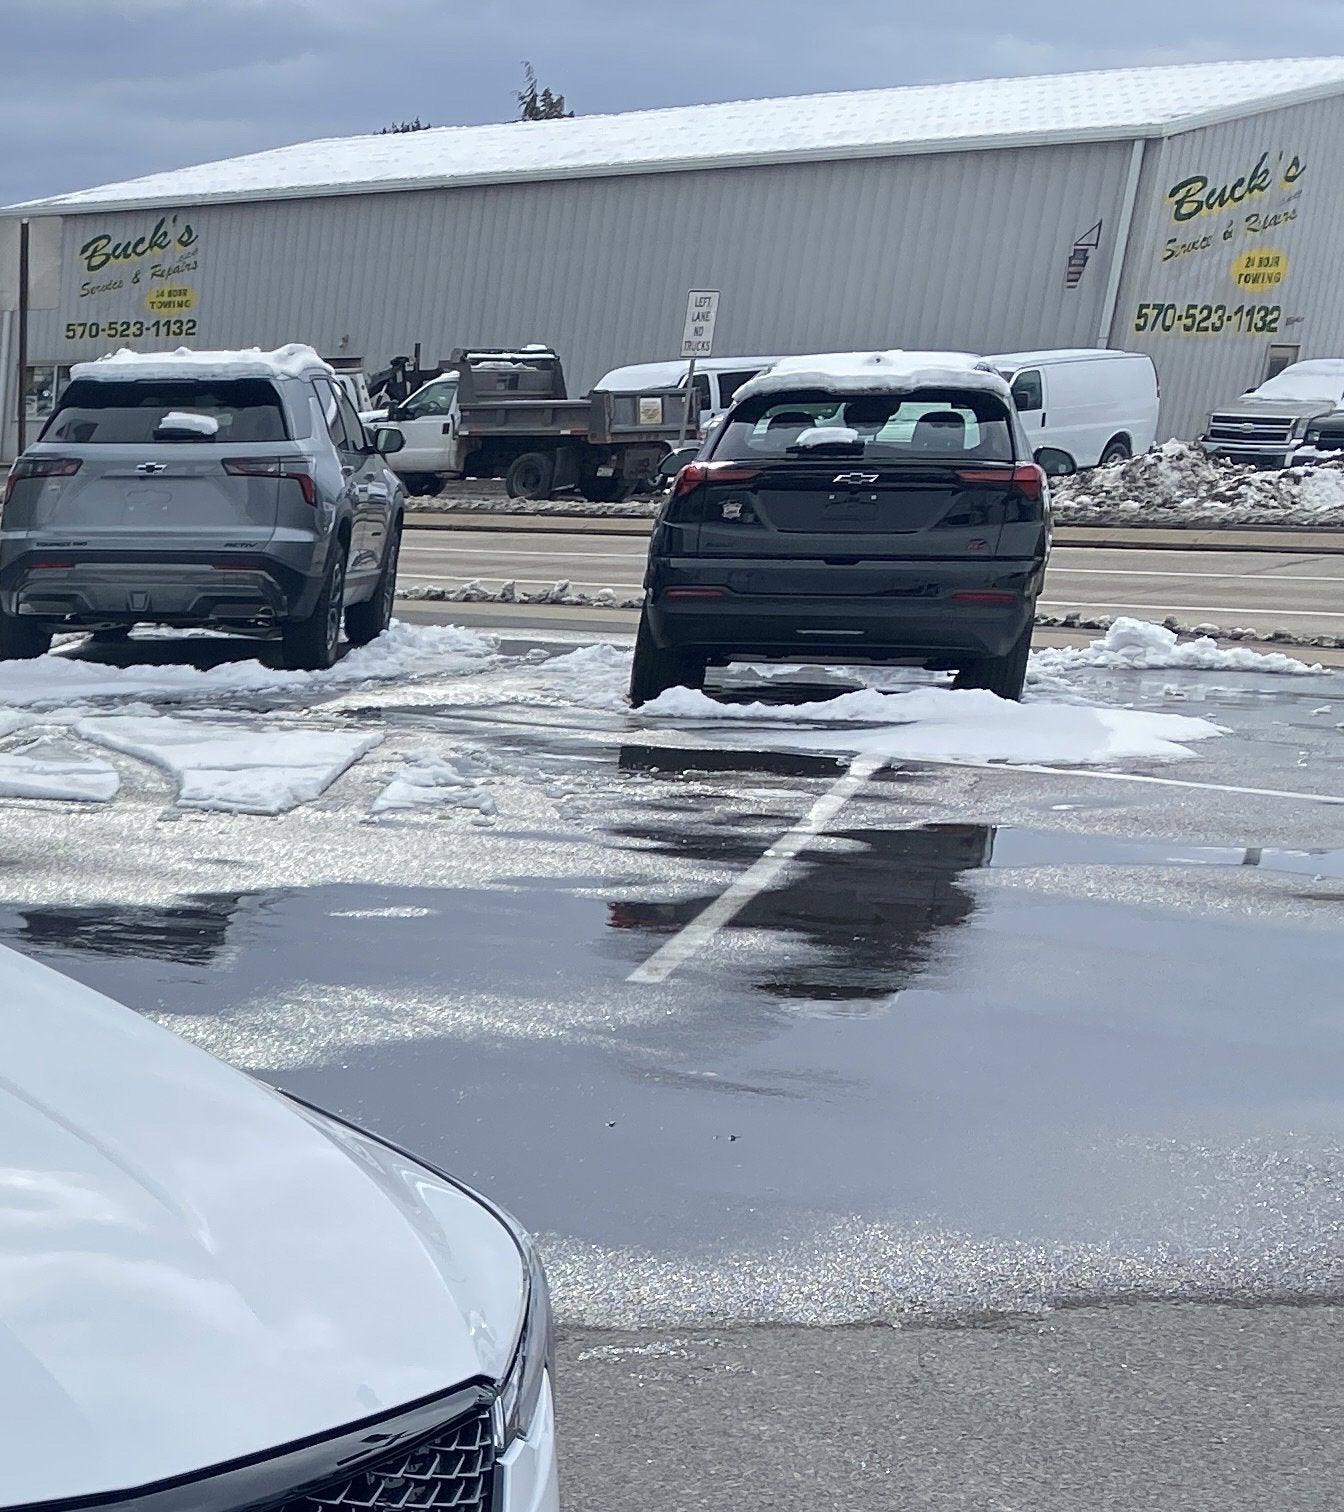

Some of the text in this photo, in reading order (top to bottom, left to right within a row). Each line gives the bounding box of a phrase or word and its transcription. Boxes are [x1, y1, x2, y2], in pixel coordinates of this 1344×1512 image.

[1168, 150, 1307, 222] Buck's
[79, 215, 199, 272] Buck's
[131, 269, 141, 285] &
[1237, 272, 1282, 284] TOWING
[149, 300, 192, 309] TOWING
[694, 296, 712, 308] LEFT
[692, 311, 712, 322] LANE
[1134, 303, 1282, 332] 570-523-1132
[65, 319, 198, 339] 570-523-1132
[684, 341, 711, 351] TRUCKS
